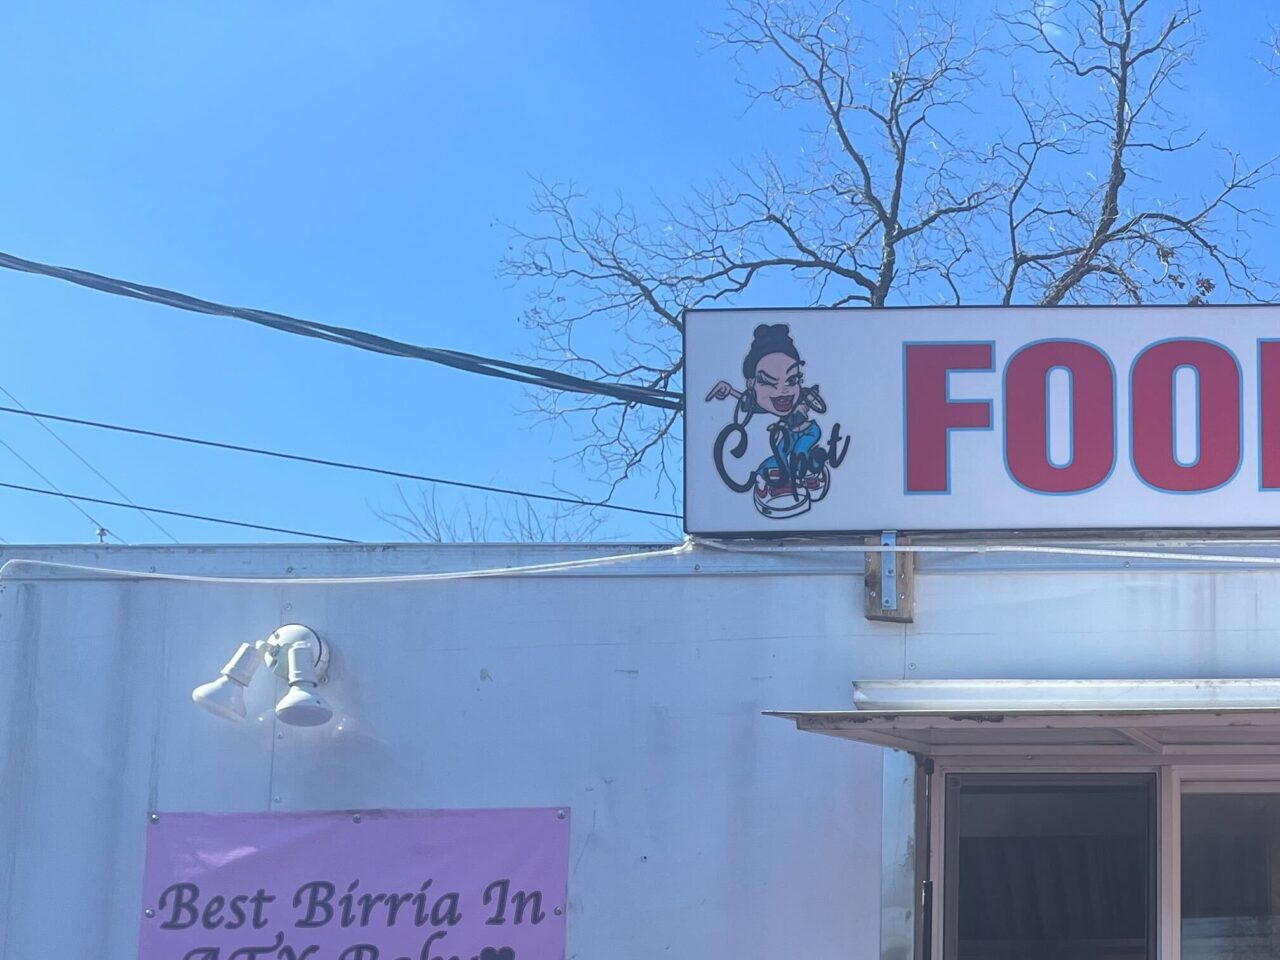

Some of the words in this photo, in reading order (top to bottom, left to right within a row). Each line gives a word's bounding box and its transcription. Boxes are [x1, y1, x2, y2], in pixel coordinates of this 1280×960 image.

[158, 882, 276, 930] Best
[292, 878, 462, 928] Birria
[483, 879, 546, 926] In
